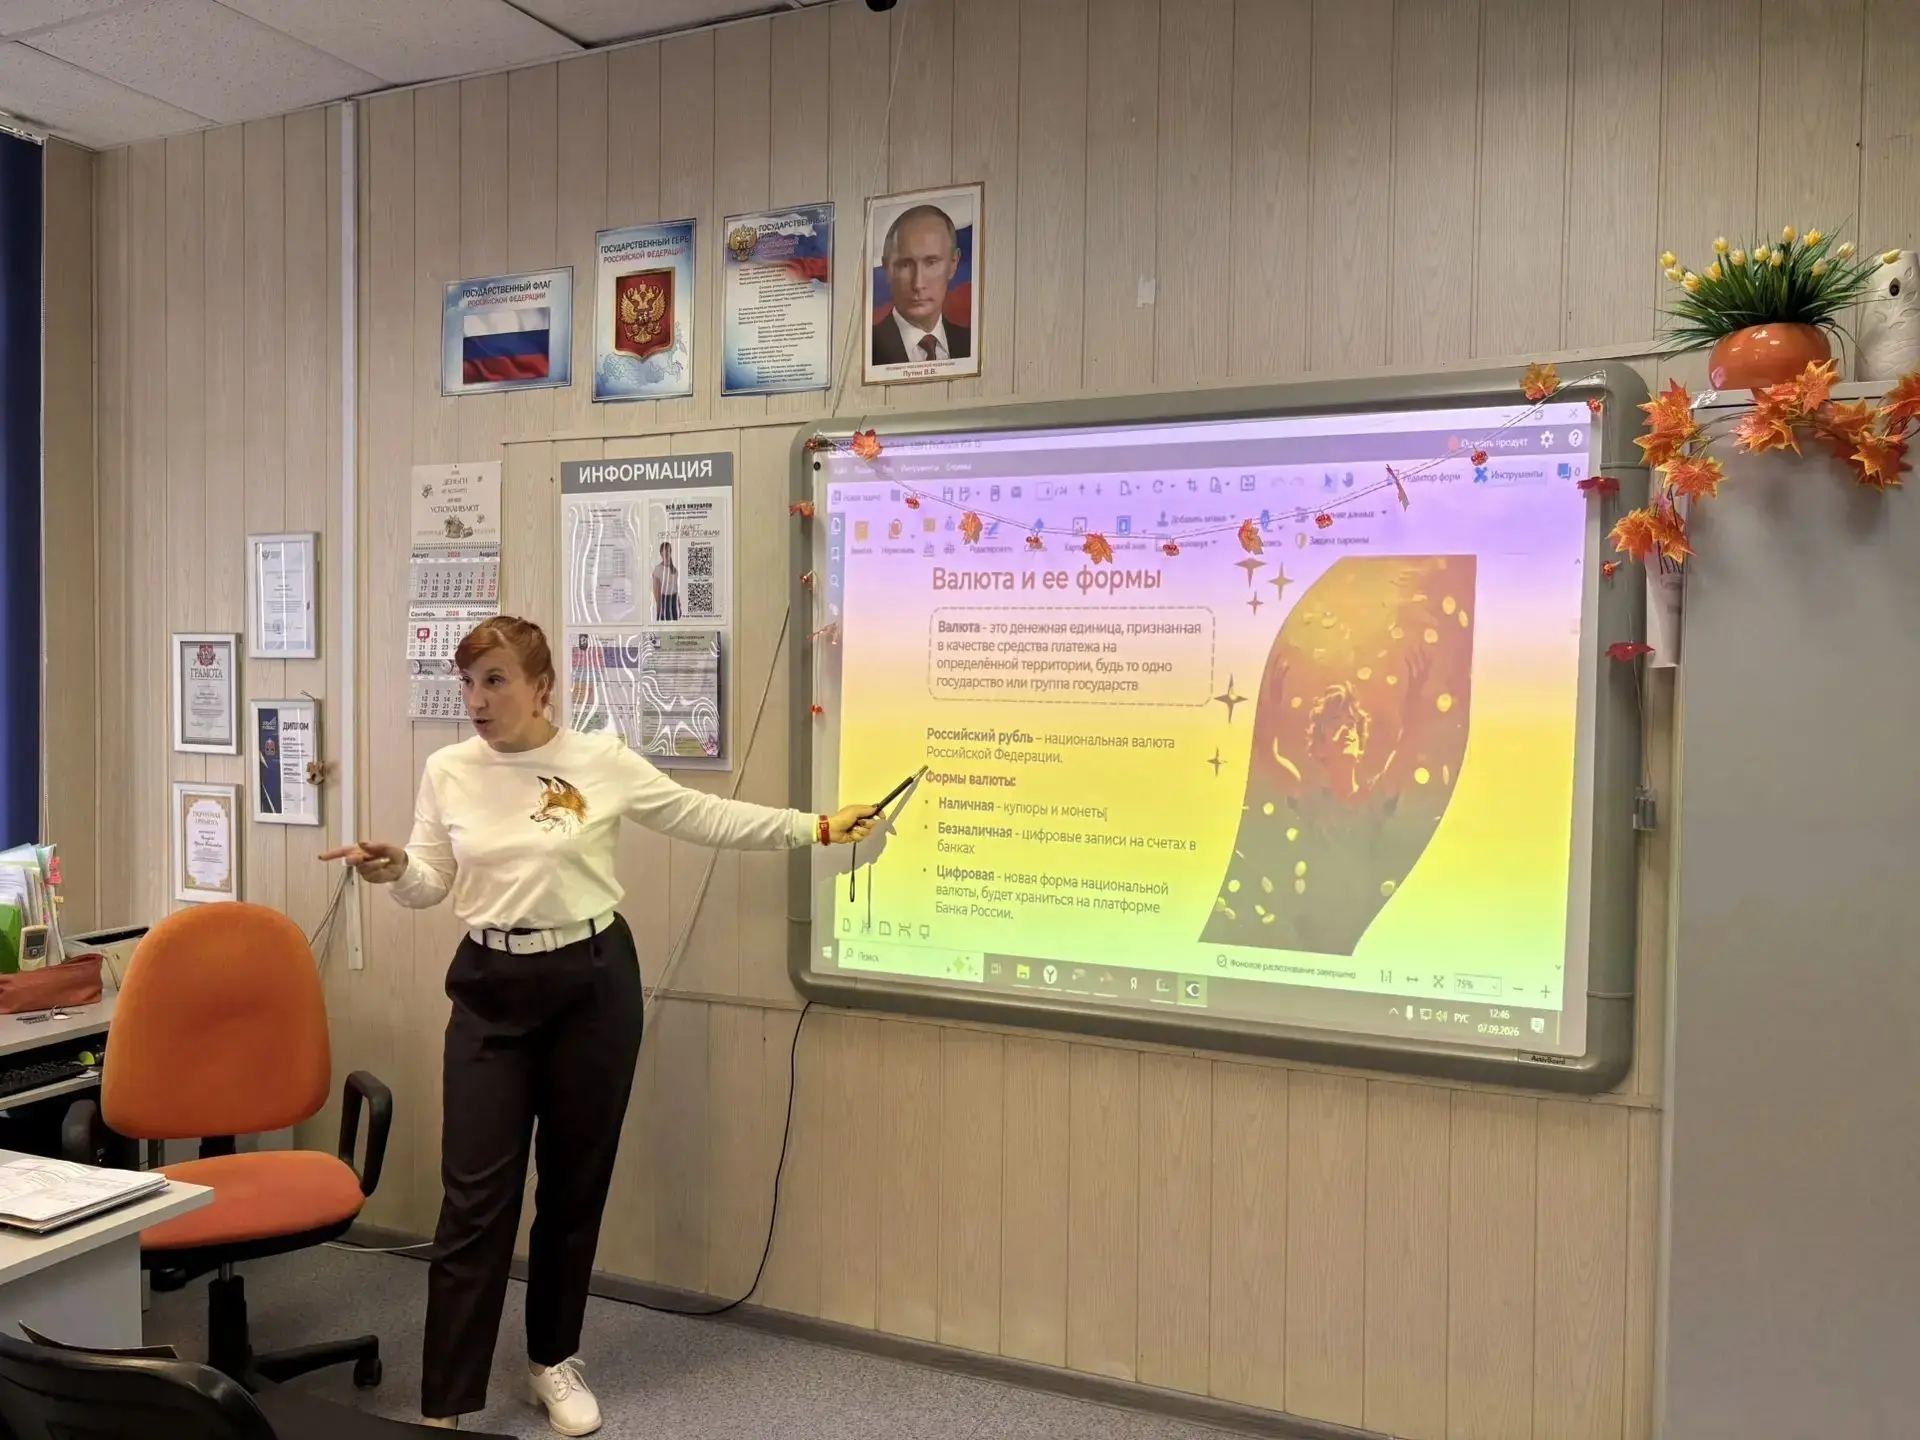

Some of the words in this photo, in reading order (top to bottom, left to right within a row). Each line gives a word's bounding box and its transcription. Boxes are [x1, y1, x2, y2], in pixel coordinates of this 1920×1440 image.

[600, 235, 670, 254] ГОСУДАРСТВЕННЫЙ
[603, 250, 645, 264] РОССИЙСКОЙ
[646, 247, 686, 259] ФЕДЕРАЦИИ
[462, 281, 531, 299] ГОСУДАРСТВЕННЫЙ
[533, 279, 553, 290] ФЛАГ
[467, 297, 508, 309] РОССИЙСКОЙ
[508, 291, 546, 303] ФЕДЕРАЦИИ
[902, 369, 923, 378] Путин
[923, 368, 938, 376] В.В.
[578, 459, 713, 484] ИНФОРМАЦИЯ
[1438, 472, 1461, 483] форм
[1491, 469, 1543, 480] Инструменты
[932, 566, 1015, 590] Валюта
[1021, 570, 1036, 590] и
[1042, 571, 1069, 590] ее
[1076, 565, 1162, 595] формы
[466, 610, 498, 619] September
[938, 620, 981, 634] Валюта
[989, 622, 1008, 634] это
[1010, 623, 1068, 636] денежная
[1069, 622, 1124, 636] единица,
[1126, 622, 1202, 636] признанная
[937, 642, 944, 651] в
[946, 641, 995, 652] качестве
[997, 642, 1049, 655] средства
[1051, 642, 1100, 653] платежа
[1102, 643, 1118, 653] на
[190, 667, 223, 678] ГРАМОТА
[936, 658, 1019, 673] определённой
[1021, 661, 1093, 673] территории,
[1096, 658, 1124, 673] будь
[1126, 662, 1139, 672] то
[1141, 661, 1172, 673] одно
[936, 677, 1004, 690] государство
[1006, 678, 1028, 689] или
[1030, 679, 1070, 692] группа
[1072, 679, 1139, 692] государств
[282, 721, 310, 732] ДИПЛОМ
[926, 727, 996, 742] Российский
[998, 730, 1034, 746] рубль
[1044, 734, 1129, 748] национальная
[1131, 736, 1175, 749] валюта
[926, 745, 992, 760] Российской
[993, 748, 1063, 764] Федерации.
[925, 770, 966, 785] Формы
[968, 773, 1016, 787] валюты:
[938, 796, 995, 812] Наличная
[1003, 803, 1048, 816] купюры
[1050, 805, 1059, 816] и
[937, 821, 1012, 839] Безналичная
[1021, 829, 1082, 844] цифровые
[1084, 834, 1127, 847] записи
[1129, 836, 1144, 848] на
[1146, 837, 1187, 851] счетах
[1189, 841, 1197, 851] в
[937, 839, 975, 855] банках
[936, 864, 995, 881] Цифровая
[1003, 872, 1038, 885] новая
[1039, 874, 1079, 890] форма
[1081, 880, 1169, 896] национальной
[935, 885, 980, 899] валюты,
[981, 886, 1013, 901] будет
[1015, 892, 1074, 907] храниться
[1076, 896, 1091, 907] на
[1093, 897, 1161, 914] платформе
[935, 901, 968, 916] Банка
[970, 904, 1014, 920] России.
[857, 951, 880, 963] Поиск
[1380, 968, 1393, 985] 1:1
[1456, 978, 1474, 990] 75%
[1454, 1012, 1470, 1024] РУС
[1489, 1008, 1511, 1020] 12:46
[1477, 1023, 1520, 1037] 07.09.2026
